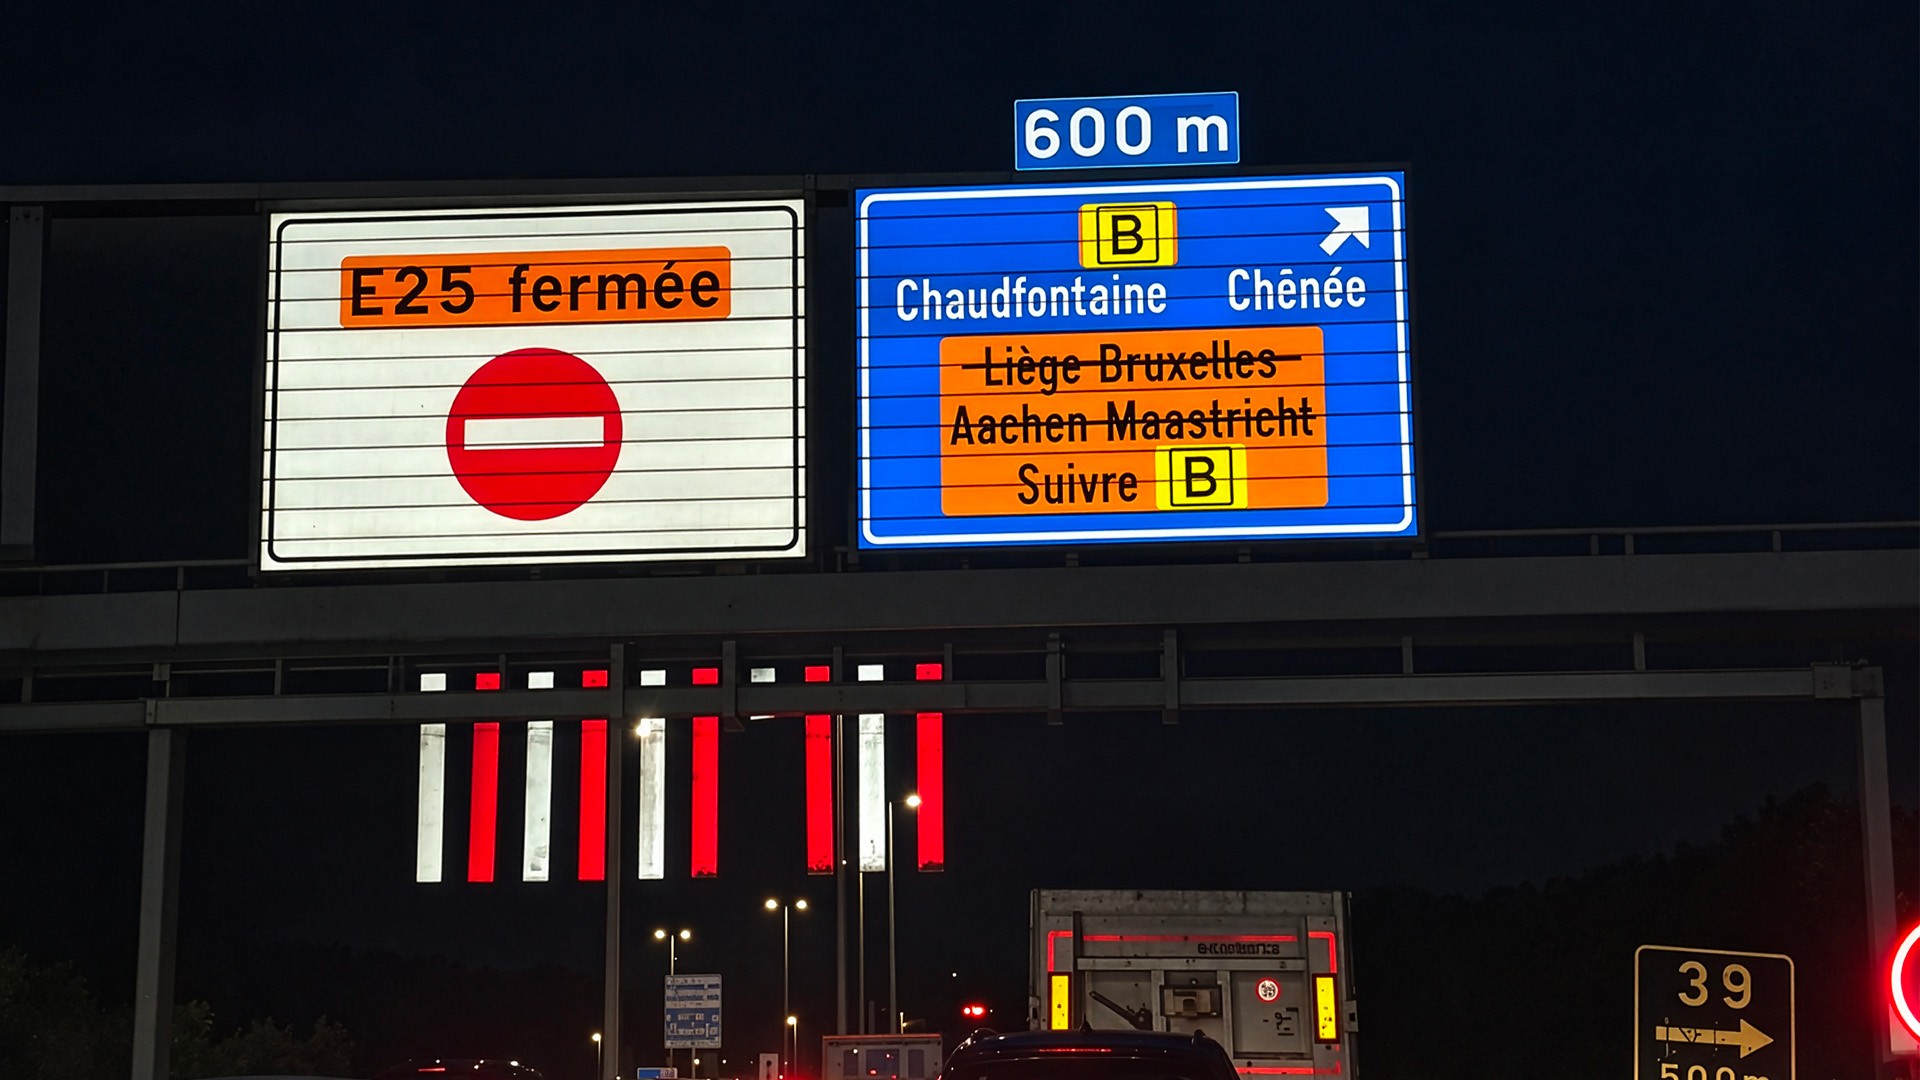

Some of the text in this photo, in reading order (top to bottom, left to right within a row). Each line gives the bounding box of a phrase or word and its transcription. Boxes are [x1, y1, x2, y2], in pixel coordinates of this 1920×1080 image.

[1024, 106, 1229, 159] 600 m
[1112, 214, 1143, 255] B
[351, 260, 721, 317] E25 fermée
[896, 274, 1167, 321] Chaudfontaine
[984, 340, 1277, 394] Liège Bruxelles
[950, 397, 1314, 446] Aachen Maastricht
[1017, 456, 1216, 505] Suivre B
[1678, 961, 1751, 1009] 39
[1660, 1063, 1770, 1080] 50
